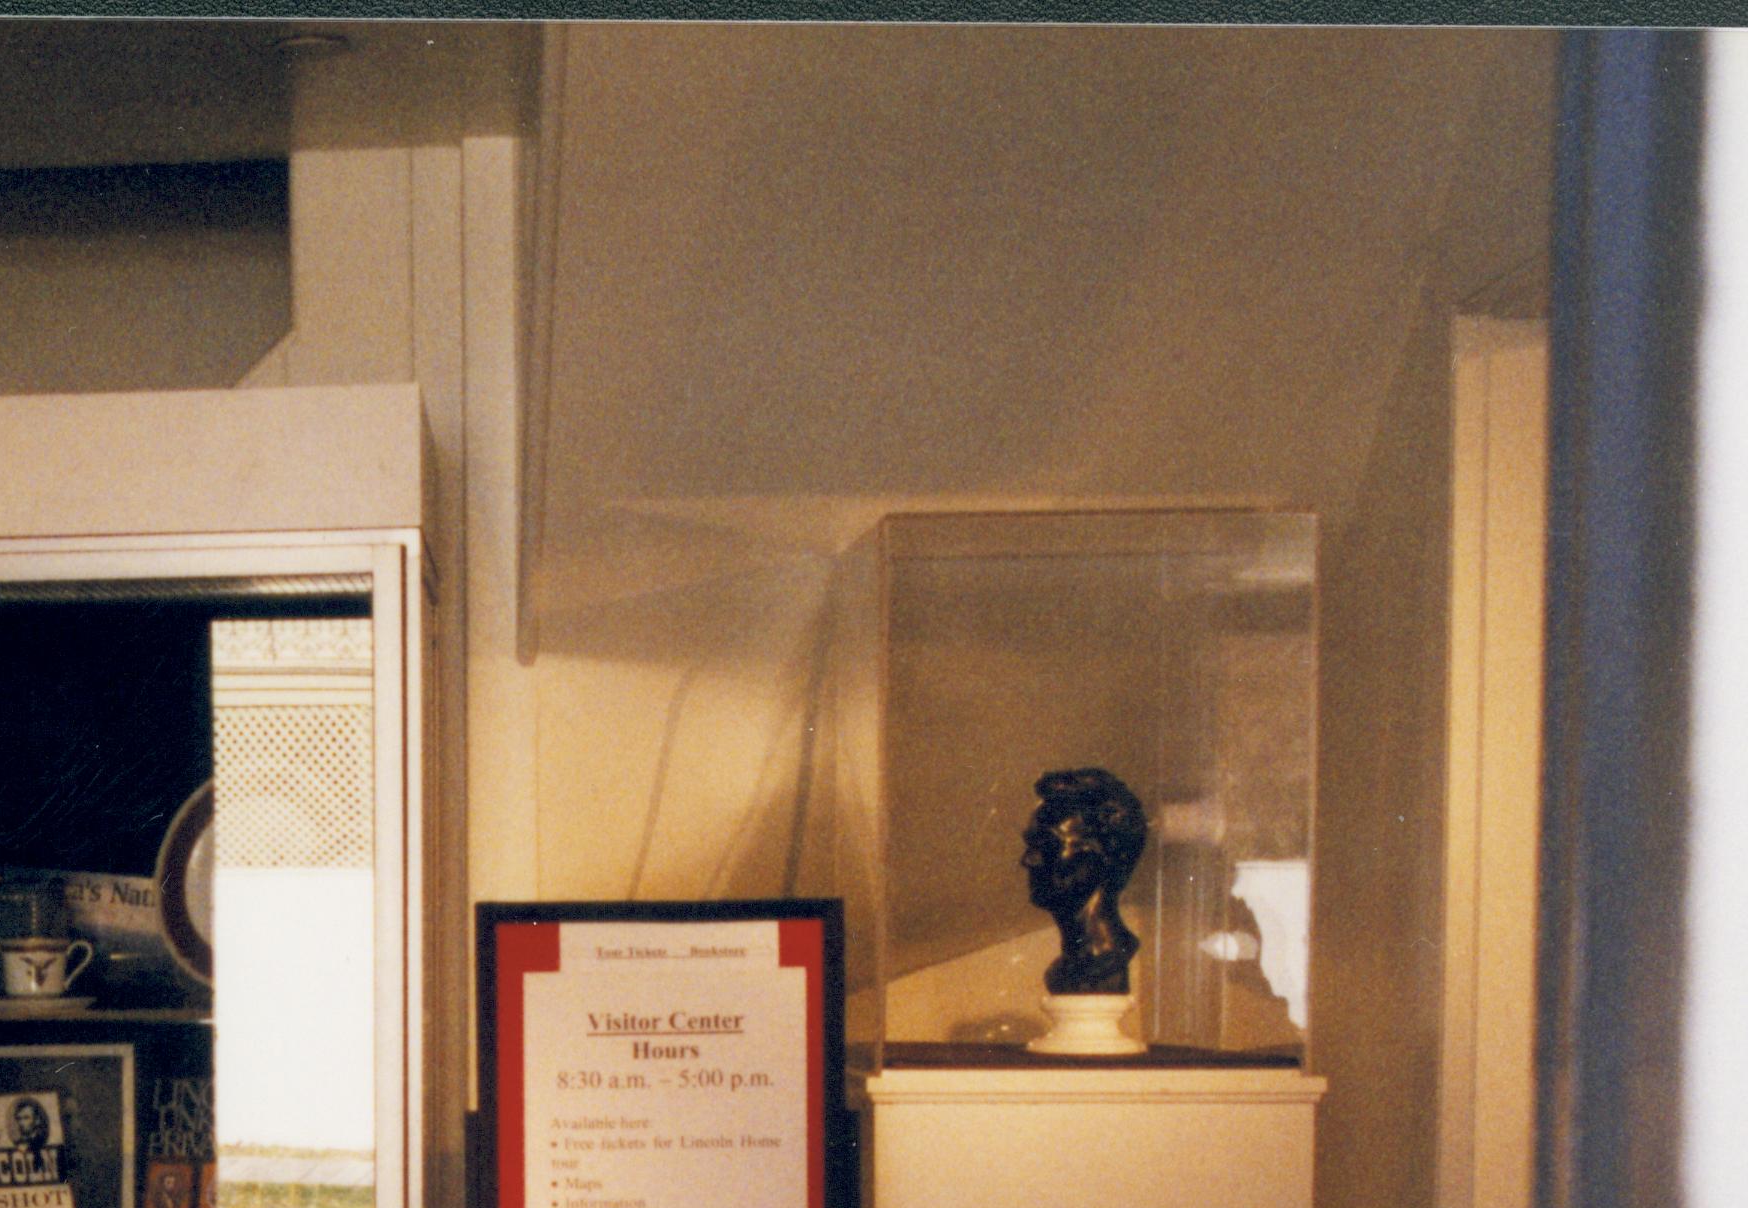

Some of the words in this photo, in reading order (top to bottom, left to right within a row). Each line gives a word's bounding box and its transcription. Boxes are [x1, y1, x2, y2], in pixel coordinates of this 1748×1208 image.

[587, 1012, 661, 1031] Visitor
[669, 1011, 744, 1029] Center
[632, 1041, 699, 1060] Hours
[557, 1071, 602, 1090] 8:30
[608, 1073, 652, 1090] a.m.
[679, 1069, 724, 1088] 5:00
[730, 1070, 774, 1091] p.m.
[551, 1117, 615, 1130] Available
[565, 1138, 594, 1150] Free
[601, 1136, 646, 1150] tickets
[653, 1136, 672, 1149] for
[680, 1135, 733, 1148] Lincoln
[740, 1135, 781, 1148] Home
[565, 1178, 602, 1191] Maps
